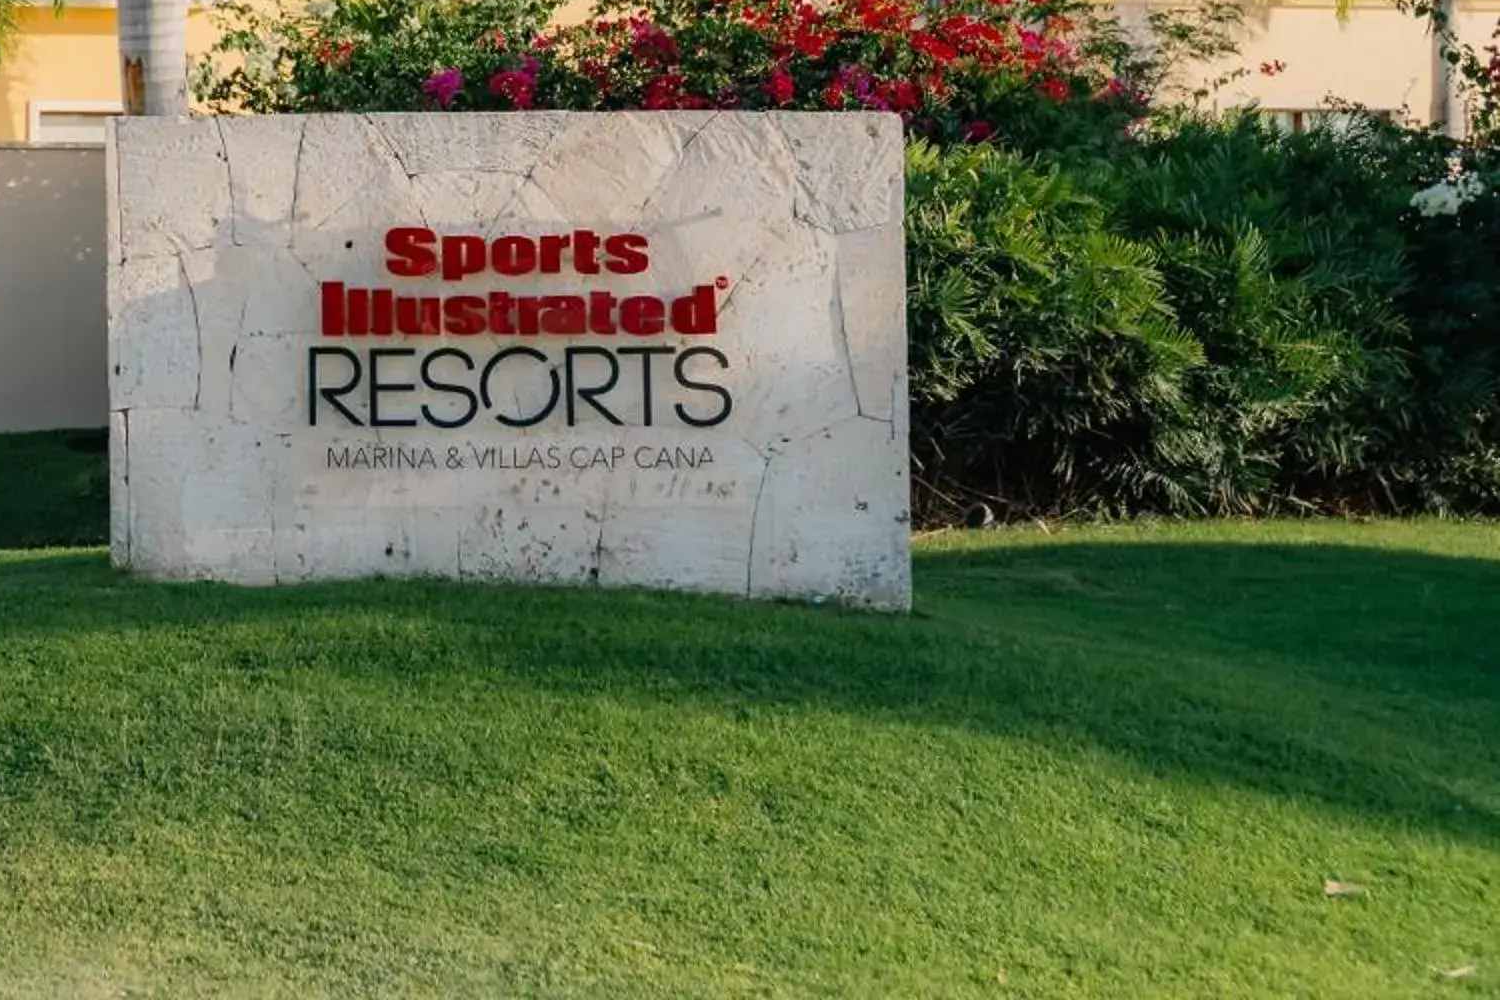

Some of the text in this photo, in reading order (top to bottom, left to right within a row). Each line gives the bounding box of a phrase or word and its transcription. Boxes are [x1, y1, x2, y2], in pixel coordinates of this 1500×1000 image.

[384, 226, 650, 281] Sports
[320, 281, 718, 338] Illustrated
[307, 345, 733, 430] RESORTS
[326, 445, 715, 473] MARINA & VILLAS CAP CANA
